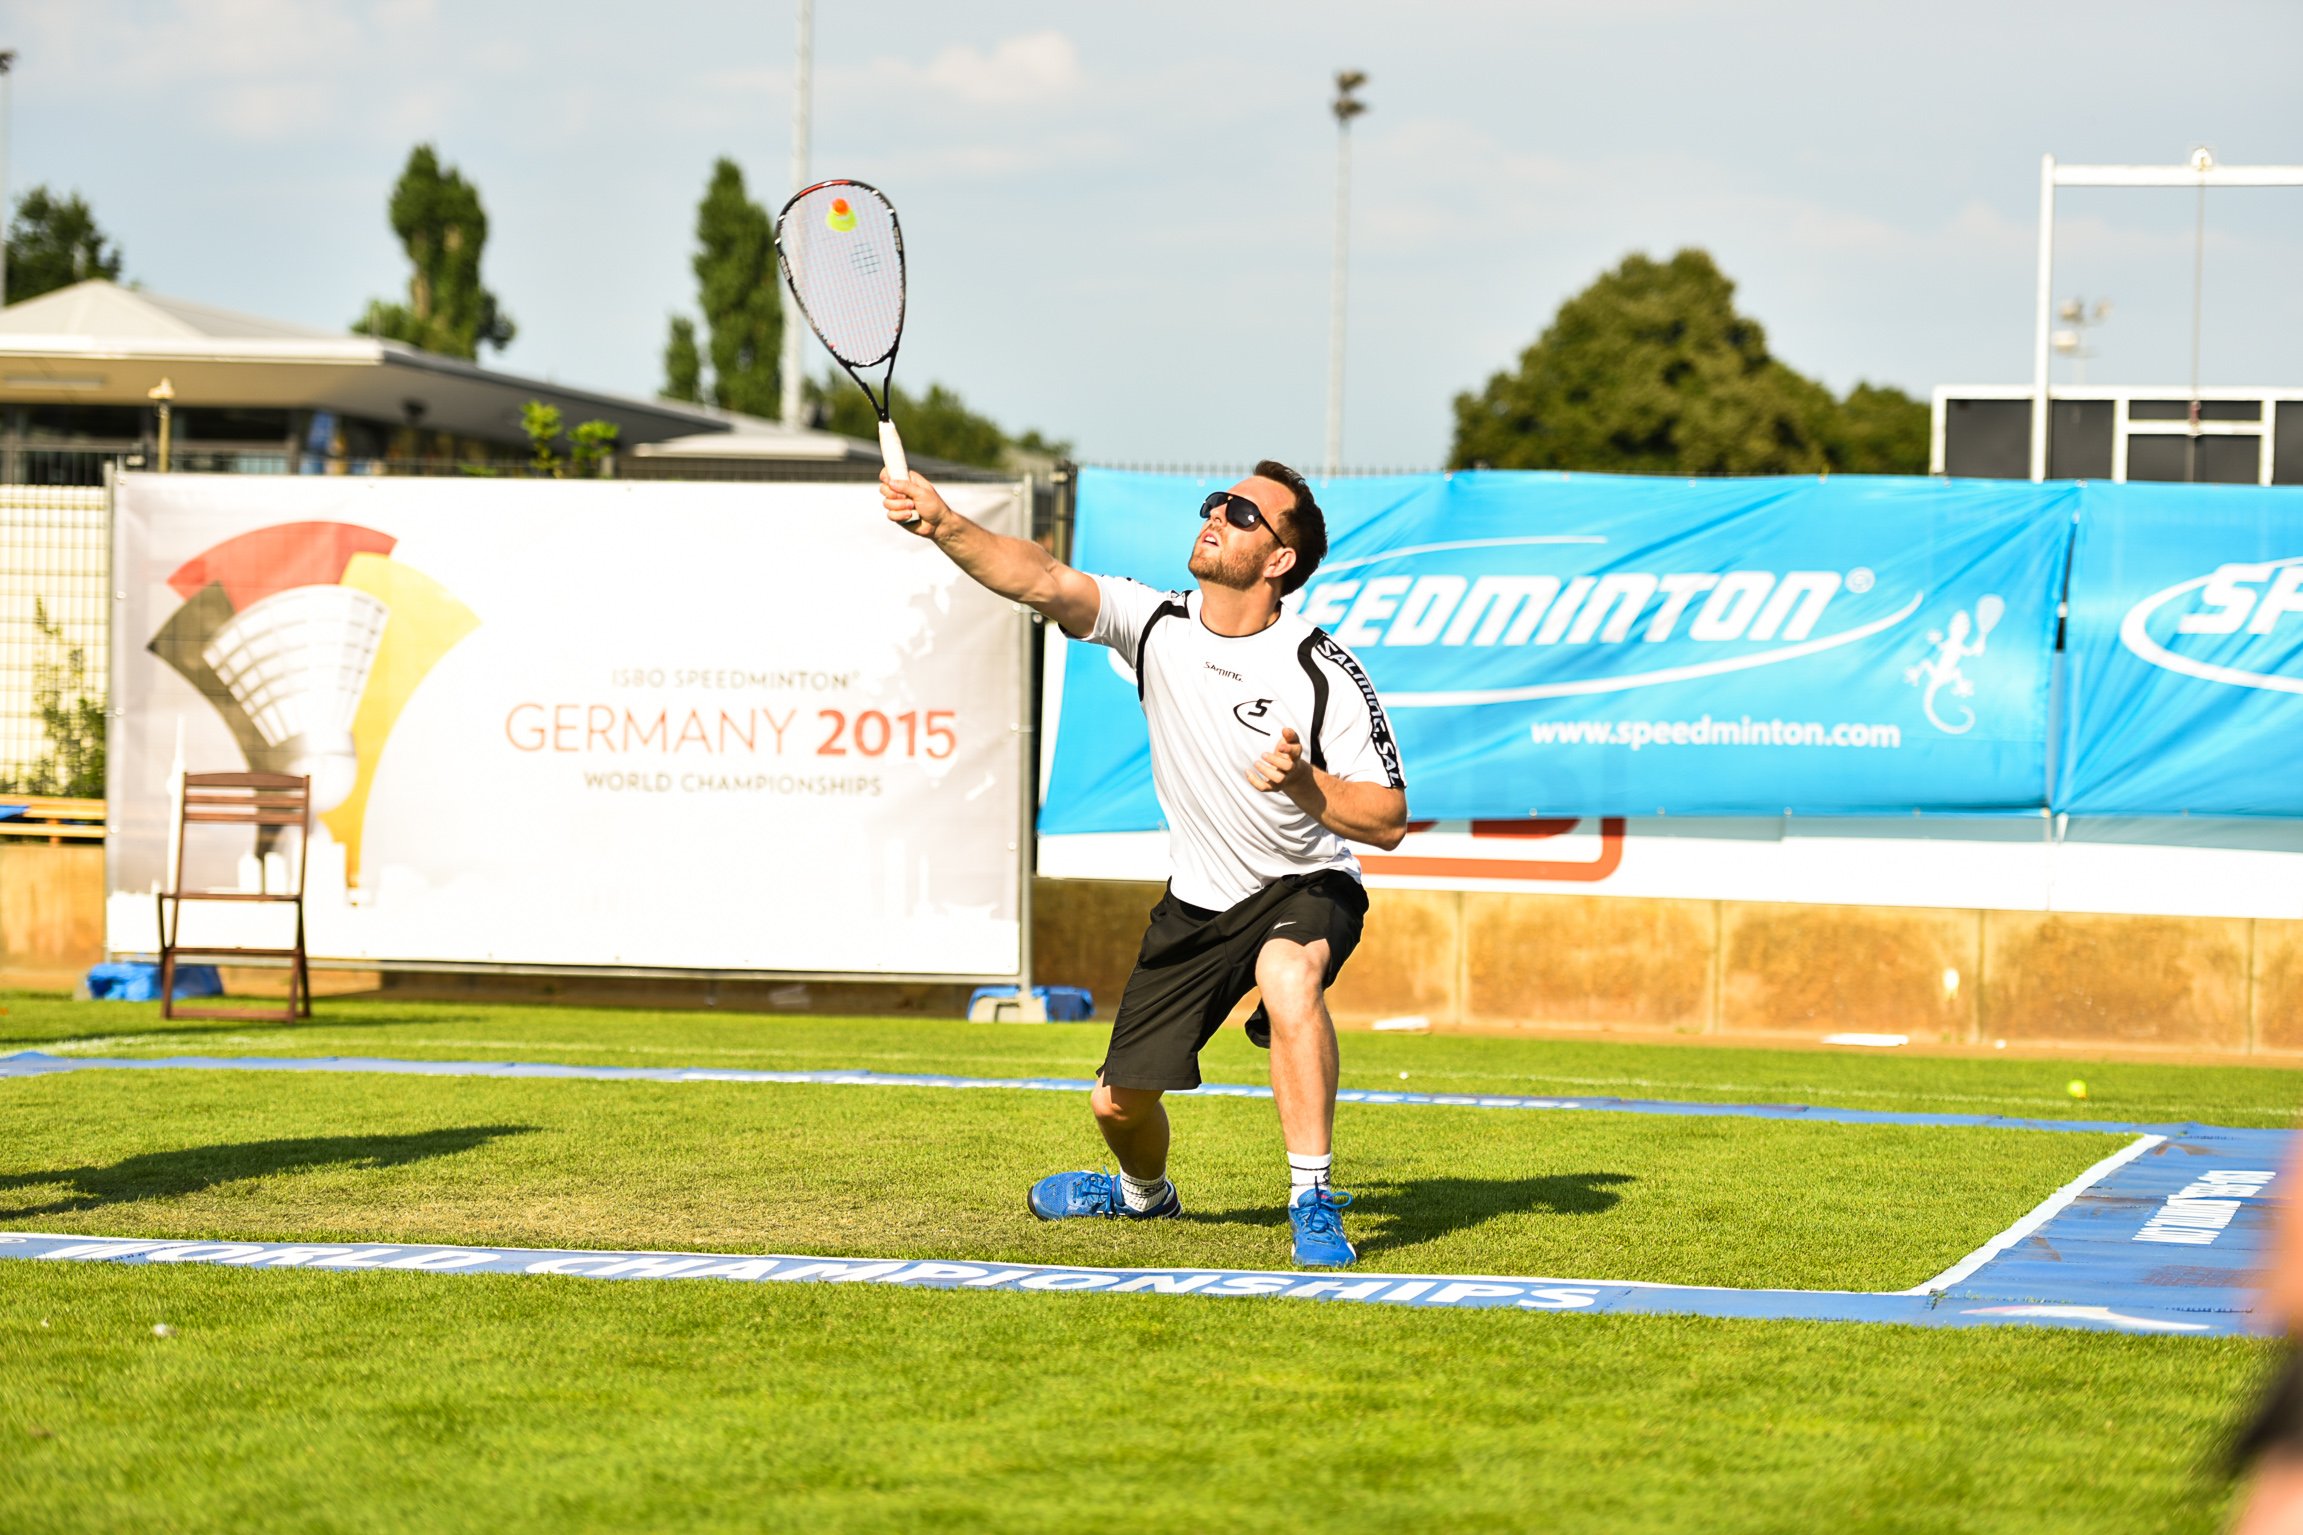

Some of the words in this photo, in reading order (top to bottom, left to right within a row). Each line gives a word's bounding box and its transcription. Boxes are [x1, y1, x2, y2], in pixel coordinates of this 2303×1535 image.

[1281, 570, 1842, 648] EEDMINTON
[505, 702, 797, 755] GERMANY
[816, 708, 958, 760] 2015
[1530, 716, 1902, 750] www.speedminton.com
[583, 770, 673, 793] WORLD
[681, 774, 884, 797] CHAMPIONSHIPS
[34, 1242, 501, 1270] WORLD
[524, 1256, 1600, 1309] CHAMPIONSHIPS
